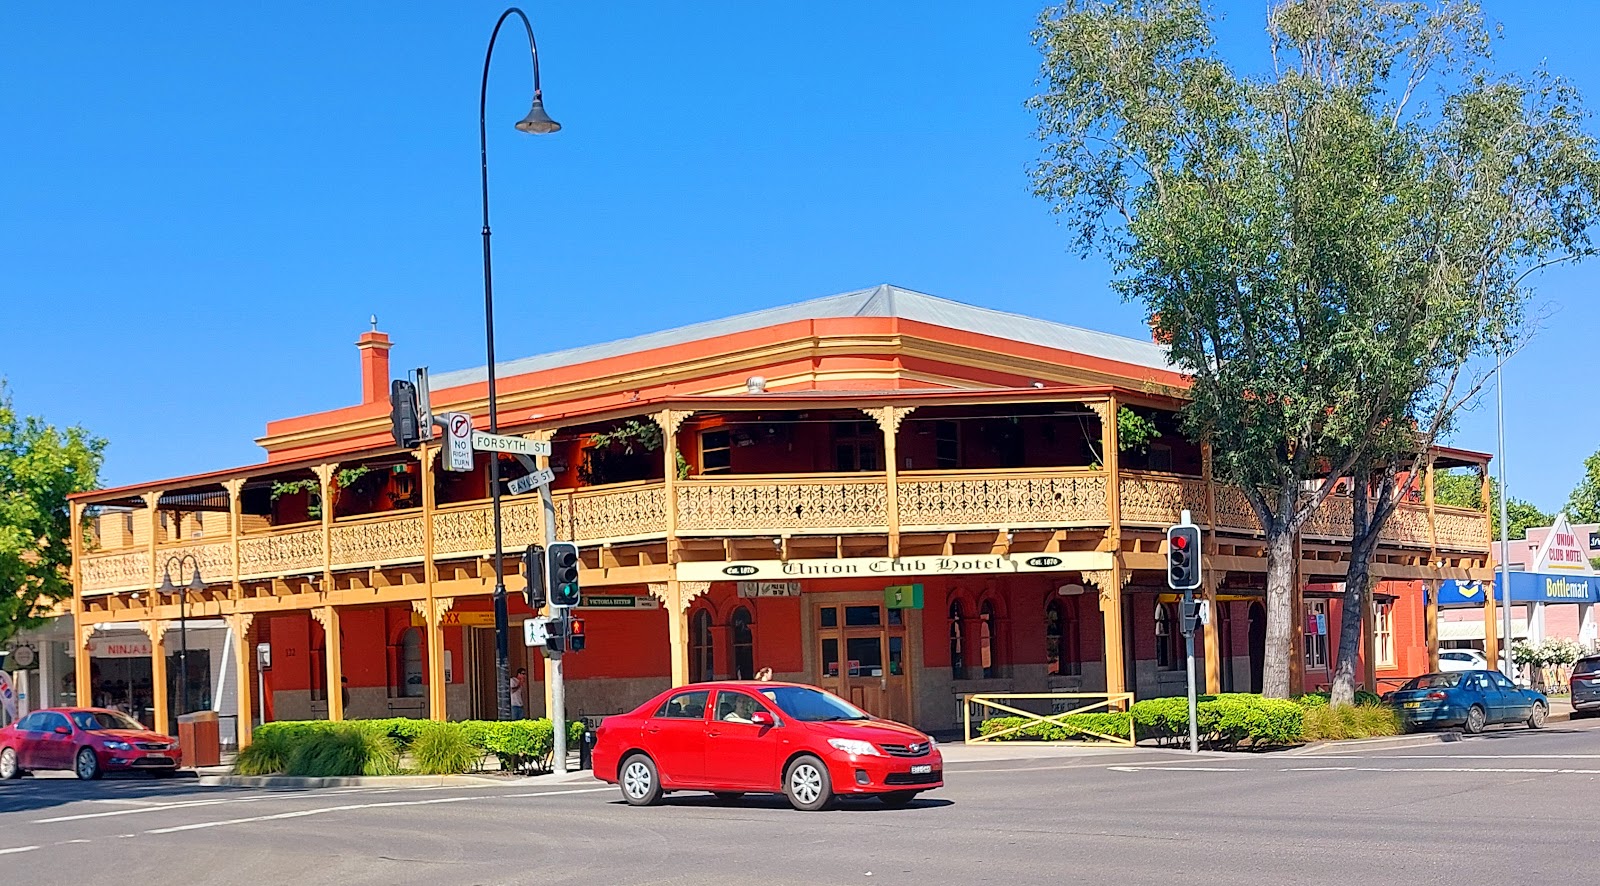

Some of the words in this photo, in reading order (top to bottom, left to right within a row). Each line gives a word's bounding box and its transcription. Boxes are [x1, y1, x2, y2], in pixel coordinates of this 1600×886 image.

[454, 440, 467, 450] NO
[477, 436, 526, 451] FORSYTH
[534, 442, 546, 453] ST
[452, 450, 469, 458] RIGHT
[454, 458, 470, 467] TURN
[510, 475, 539, 493] BAYLIS
[540, 470, 550, 480] ST
[1556, 533, 1575, 547] UNION
[1548, 548, 1564, 561] CLUB
[781, 562, 858, 575] Union
[868, 559, 926, 573] Club
[935, 557, 1002, 573] Hotel
[1546, 577, 1589, 599] Bottlemart
[108, 644, 139, 654] NINJA
